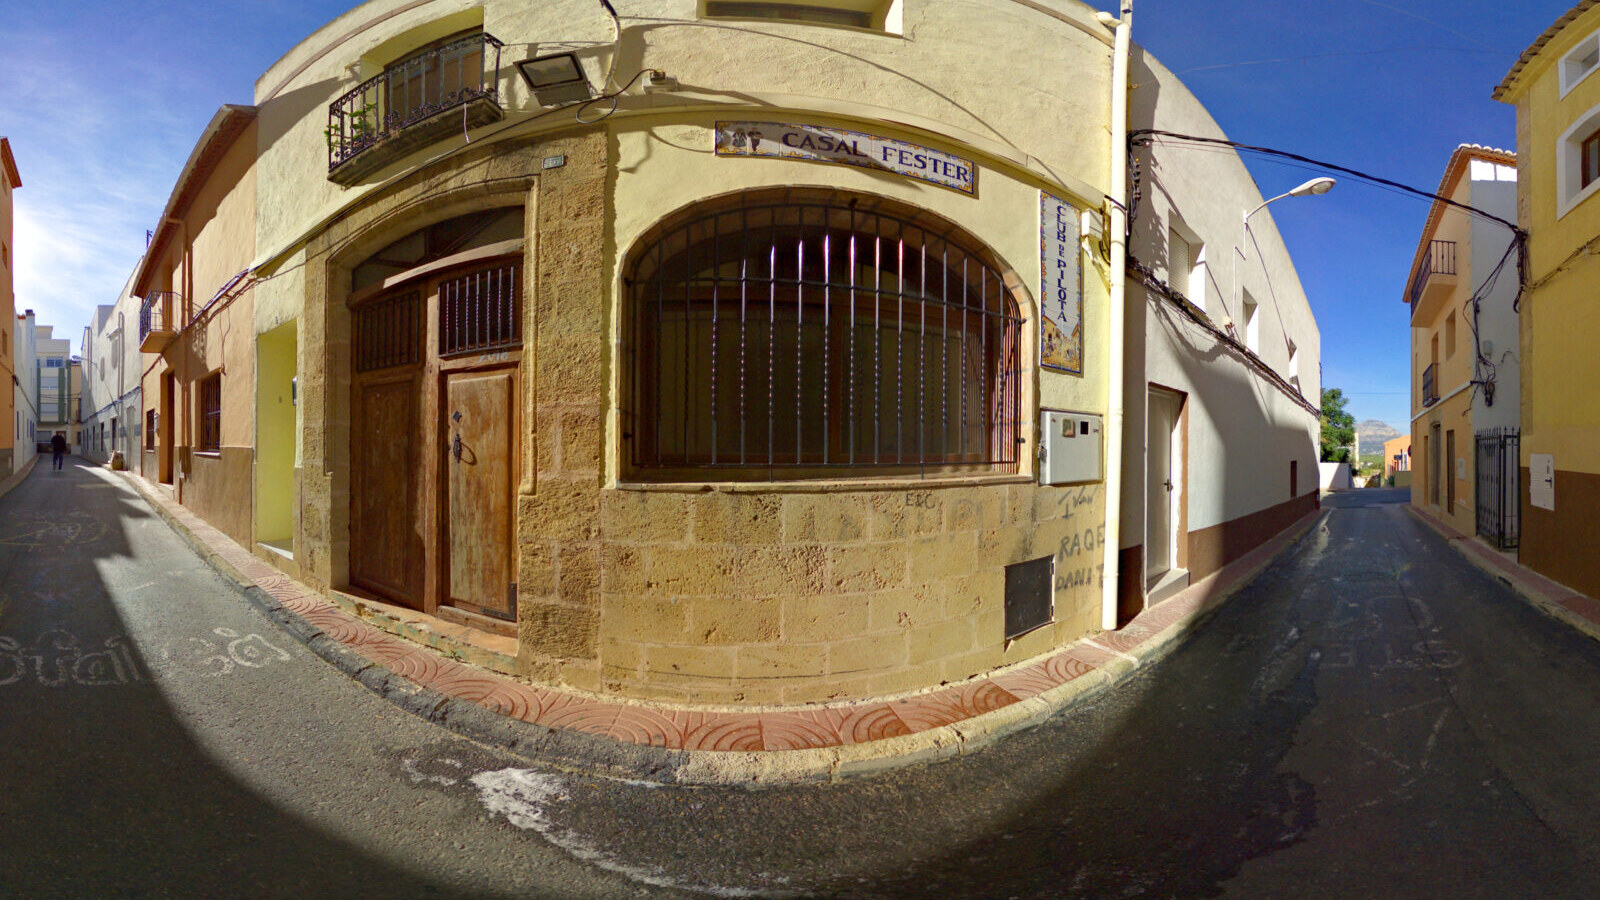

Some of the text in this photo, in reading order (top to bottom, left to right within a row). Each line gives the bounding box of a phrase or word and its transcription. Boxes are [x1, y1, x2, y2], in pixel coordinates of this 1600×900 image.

[782, 132, 969, 183] CASAL FESTER
[1056, 205, 1067, 243] CLUB
[1056, 259, 1068, 323] PILOTA
